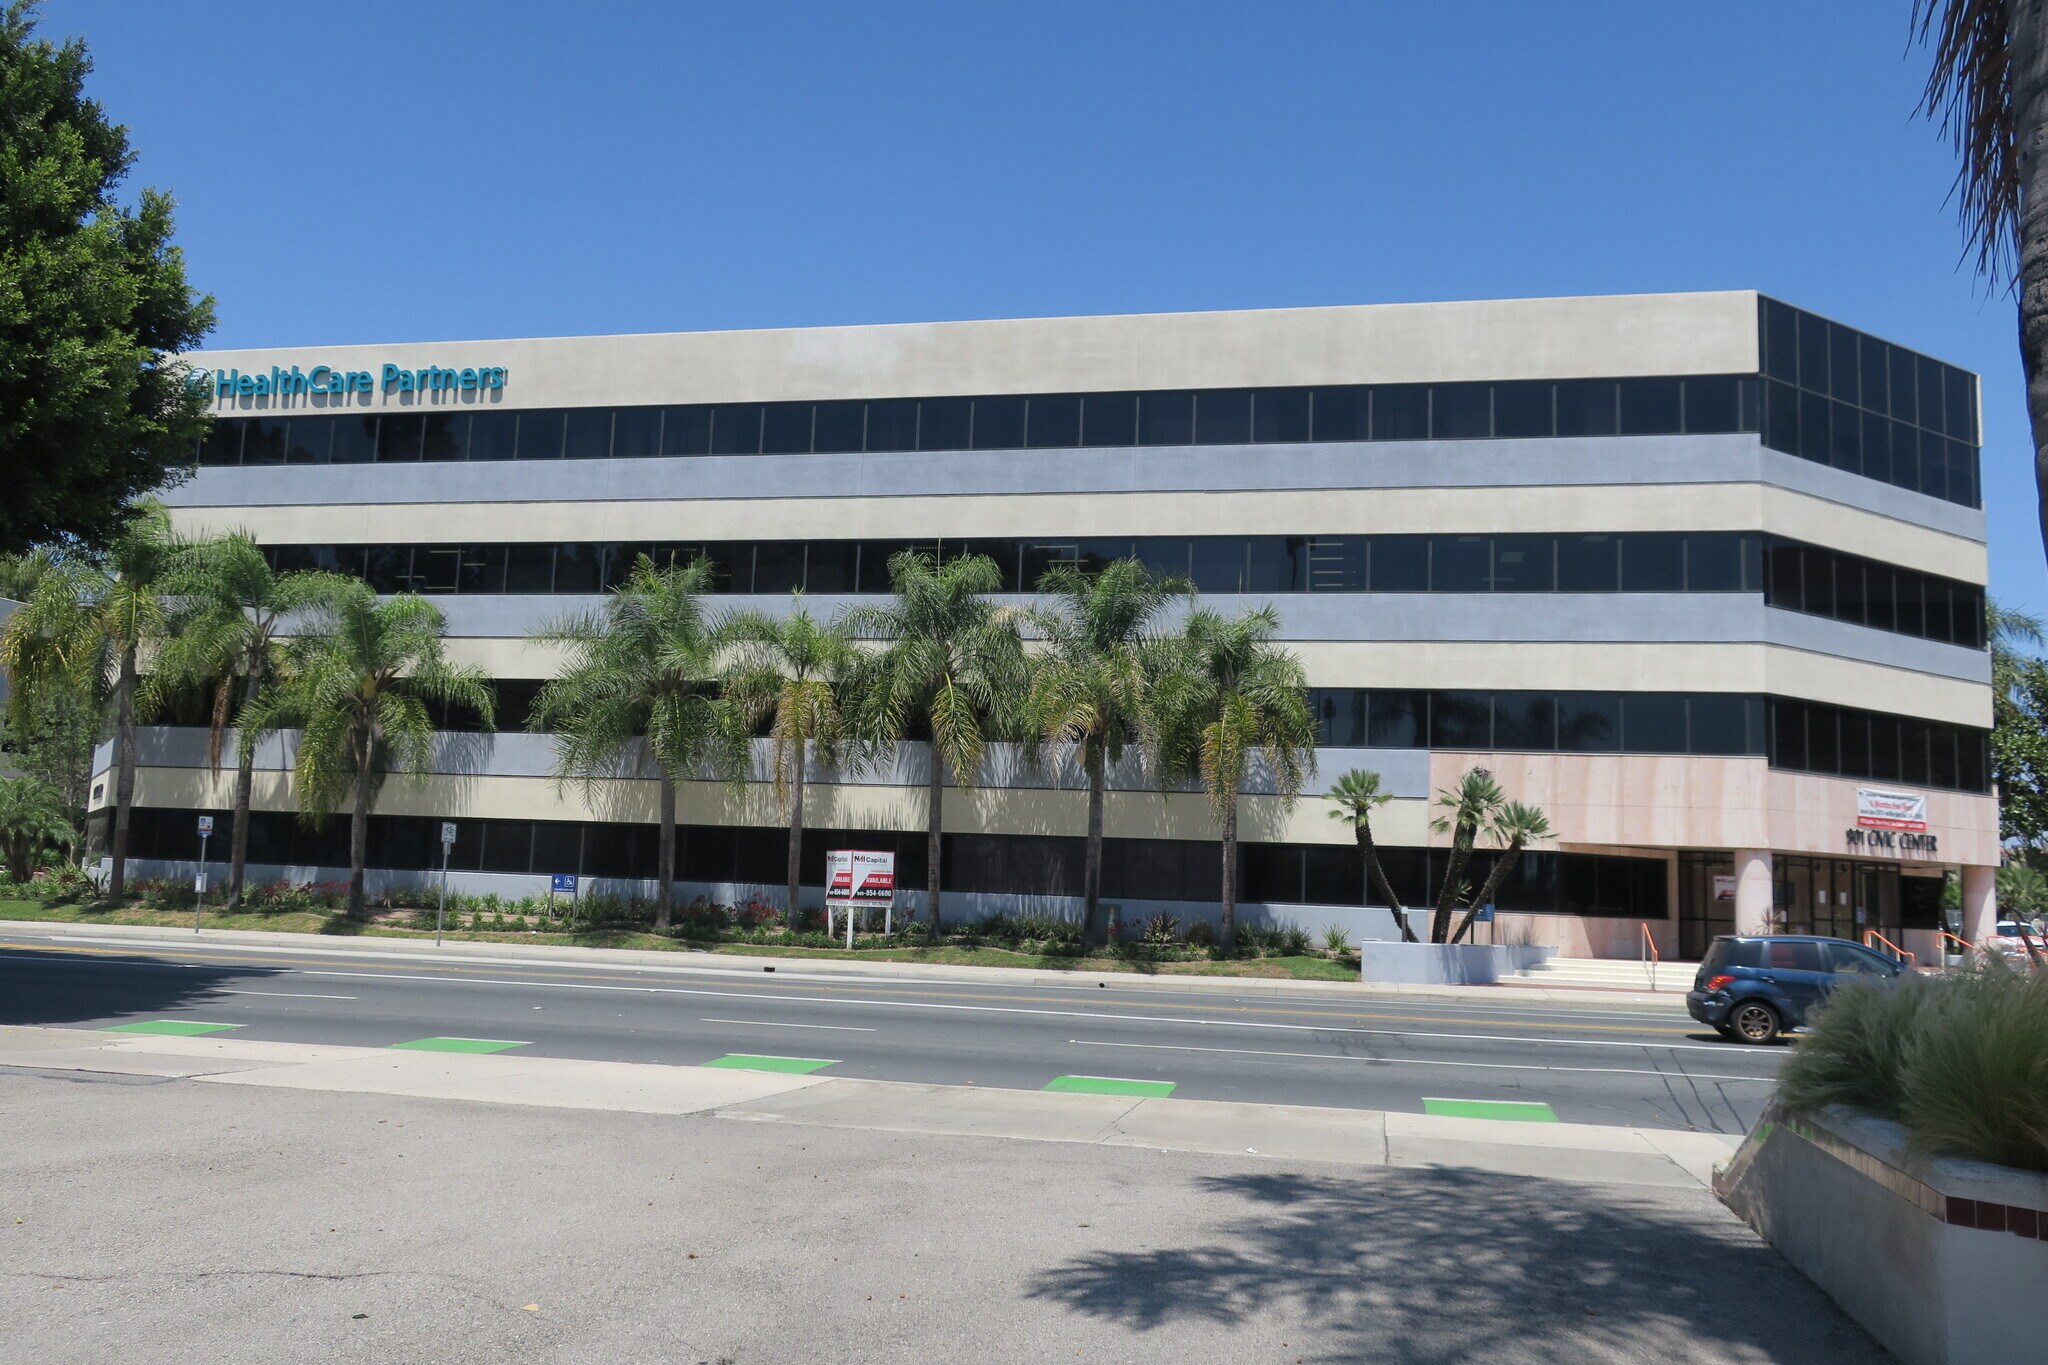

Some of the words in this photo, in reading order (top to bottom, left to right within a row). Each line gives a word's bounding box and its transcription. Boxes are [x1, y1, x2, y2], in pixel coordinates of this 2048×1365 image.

[215, 364, 374, 397] HealthCare
[381, 363, 504, 392] Partners
[1868, 829, 1897, 848] CIVIC
[1899, 832, 1938, 852] CENTER
